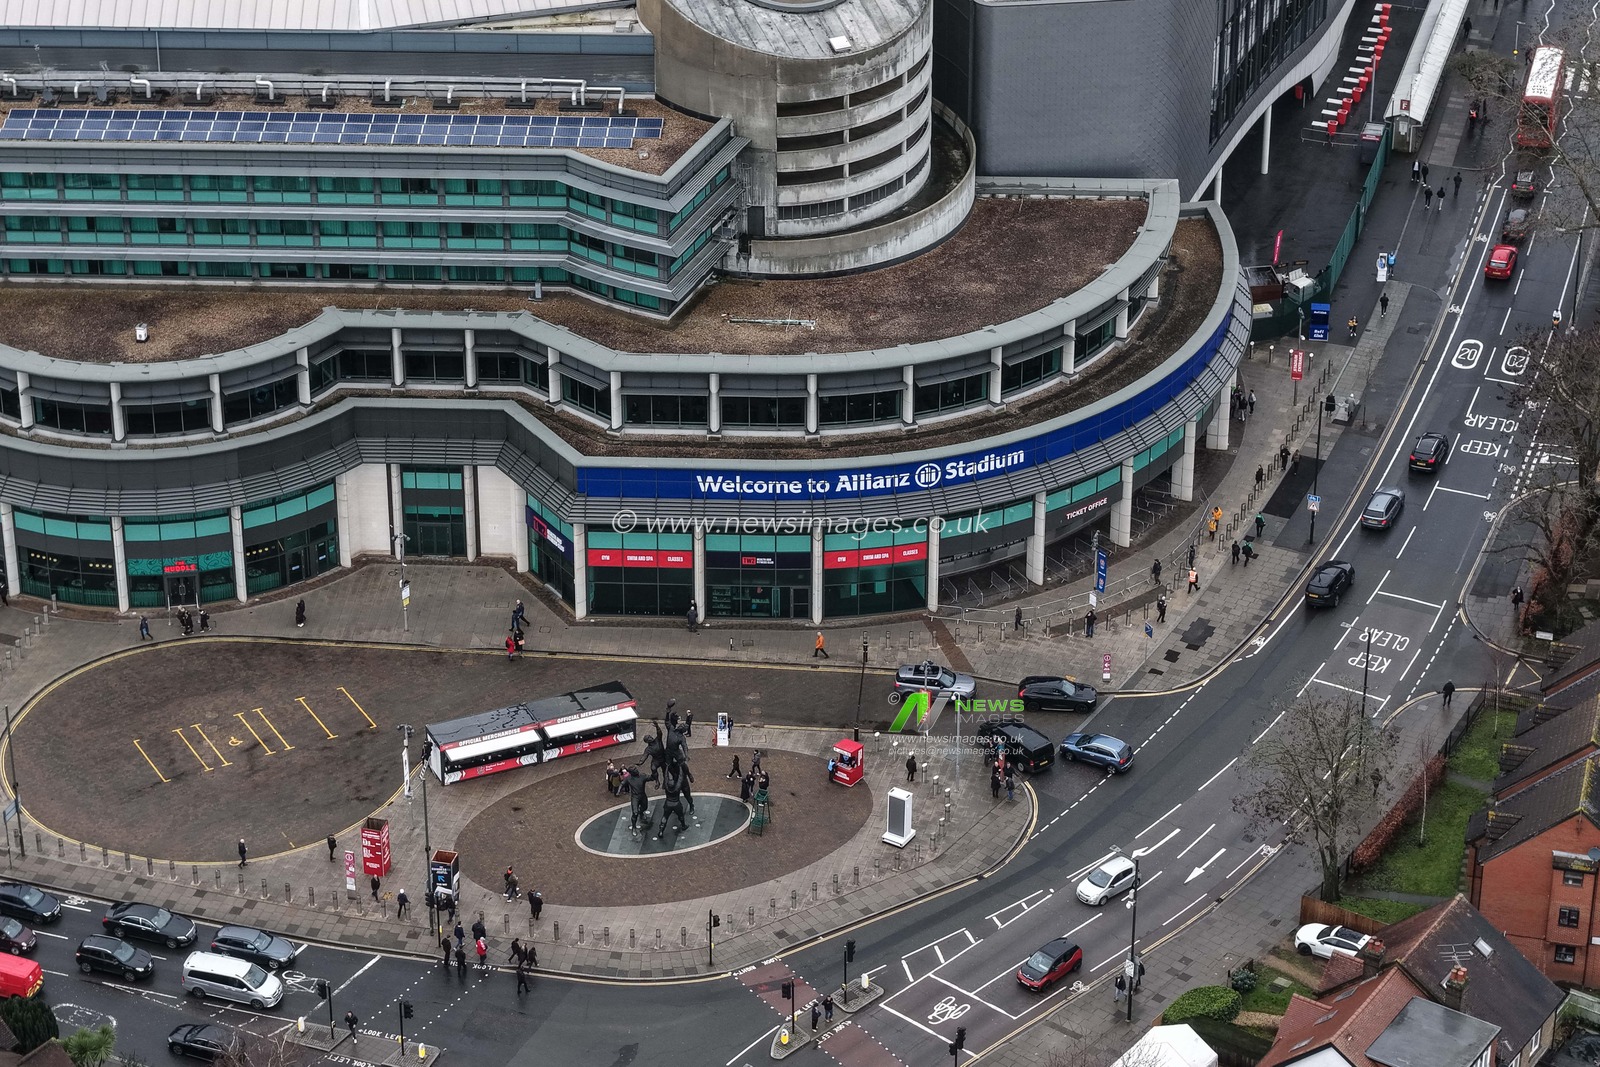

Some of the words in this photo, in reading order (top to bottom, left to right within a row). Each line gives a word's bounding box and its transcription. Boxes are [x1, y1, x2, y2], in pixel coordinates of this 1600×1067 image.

[1458, 348, 1478, 360] 20
[1507, 354, 1525, 367] 20
[1464, 413, 1515, 433] CLEAR
[1460, 440, 1501, 456] KEEP
[696, 475, 802, 494] Welcome
[807, 478, 830, 494] to
[836, 472, 910, 492] Allianz
[945, 450, 1024, 480] Stadium
[1066, 506, 1088, 520] TICKET
[1088, 498, 1108, 510] OFFICE
[1359, 627, 1410, 651] CLEAR
[1348, 652, 1392, 674] KEEP
[557, 714, 580, 723] OFFICIAL
[580, 706, 618, 718] MERCHANDISE
[458, 736, 481, 746] OFFICIAL
[482, 728, 520, 741] MERCHANDISE
[802, 999, 818, 1010] LEFT
[363, 1029, 382, 1037] LOOK
[832, 1022, 850, 1033] LOOK
[816, 1032, 834, 1044] LEFT
[327, 1054, 350, 1064] LEFT
